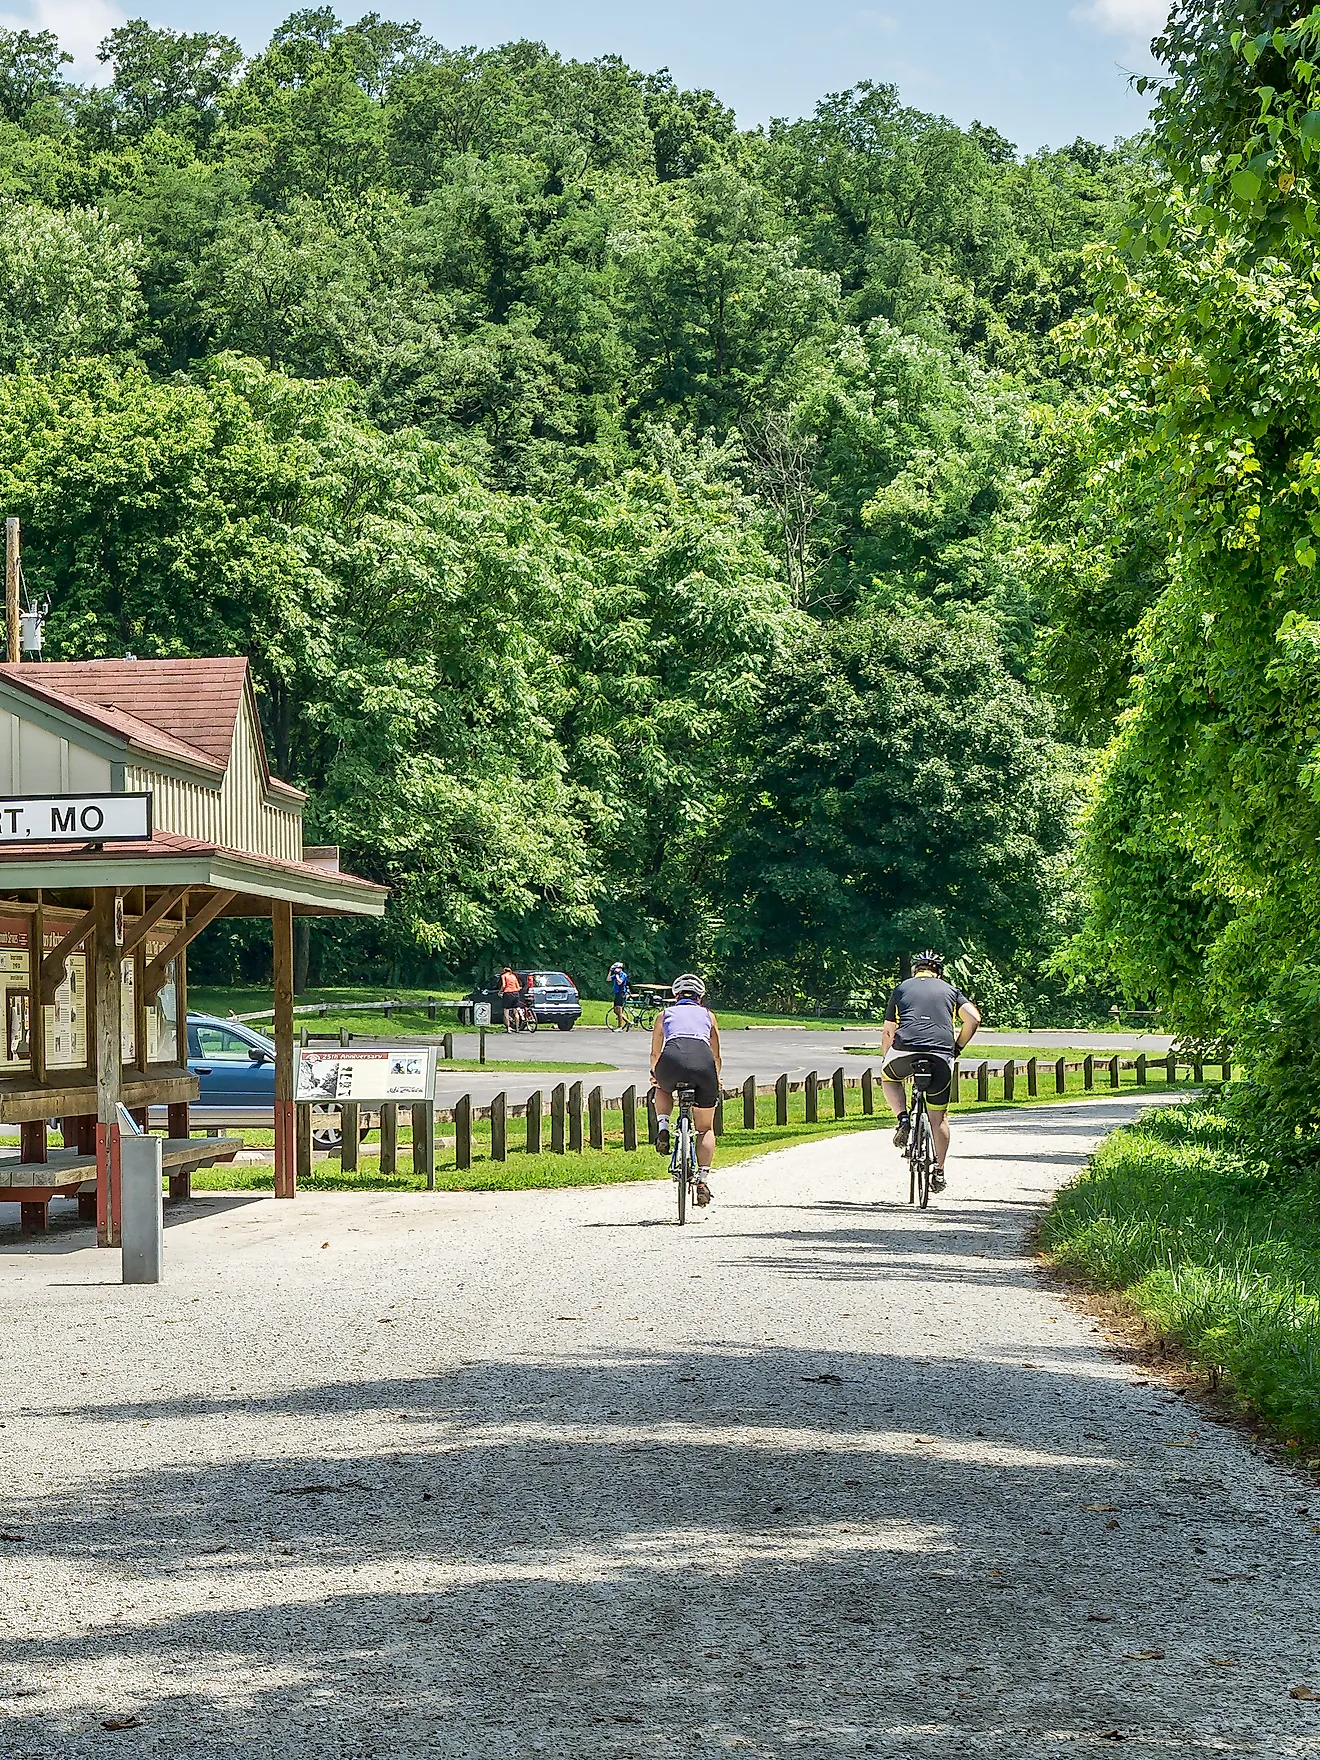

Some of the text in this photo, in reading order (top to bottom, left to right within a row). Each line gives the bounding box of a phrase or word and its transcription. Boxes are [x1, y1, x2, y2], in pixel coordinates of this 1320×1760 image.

[50, 805, 105, 833] MO
[322, 1052, 383, 1060] 25th Anniversary
